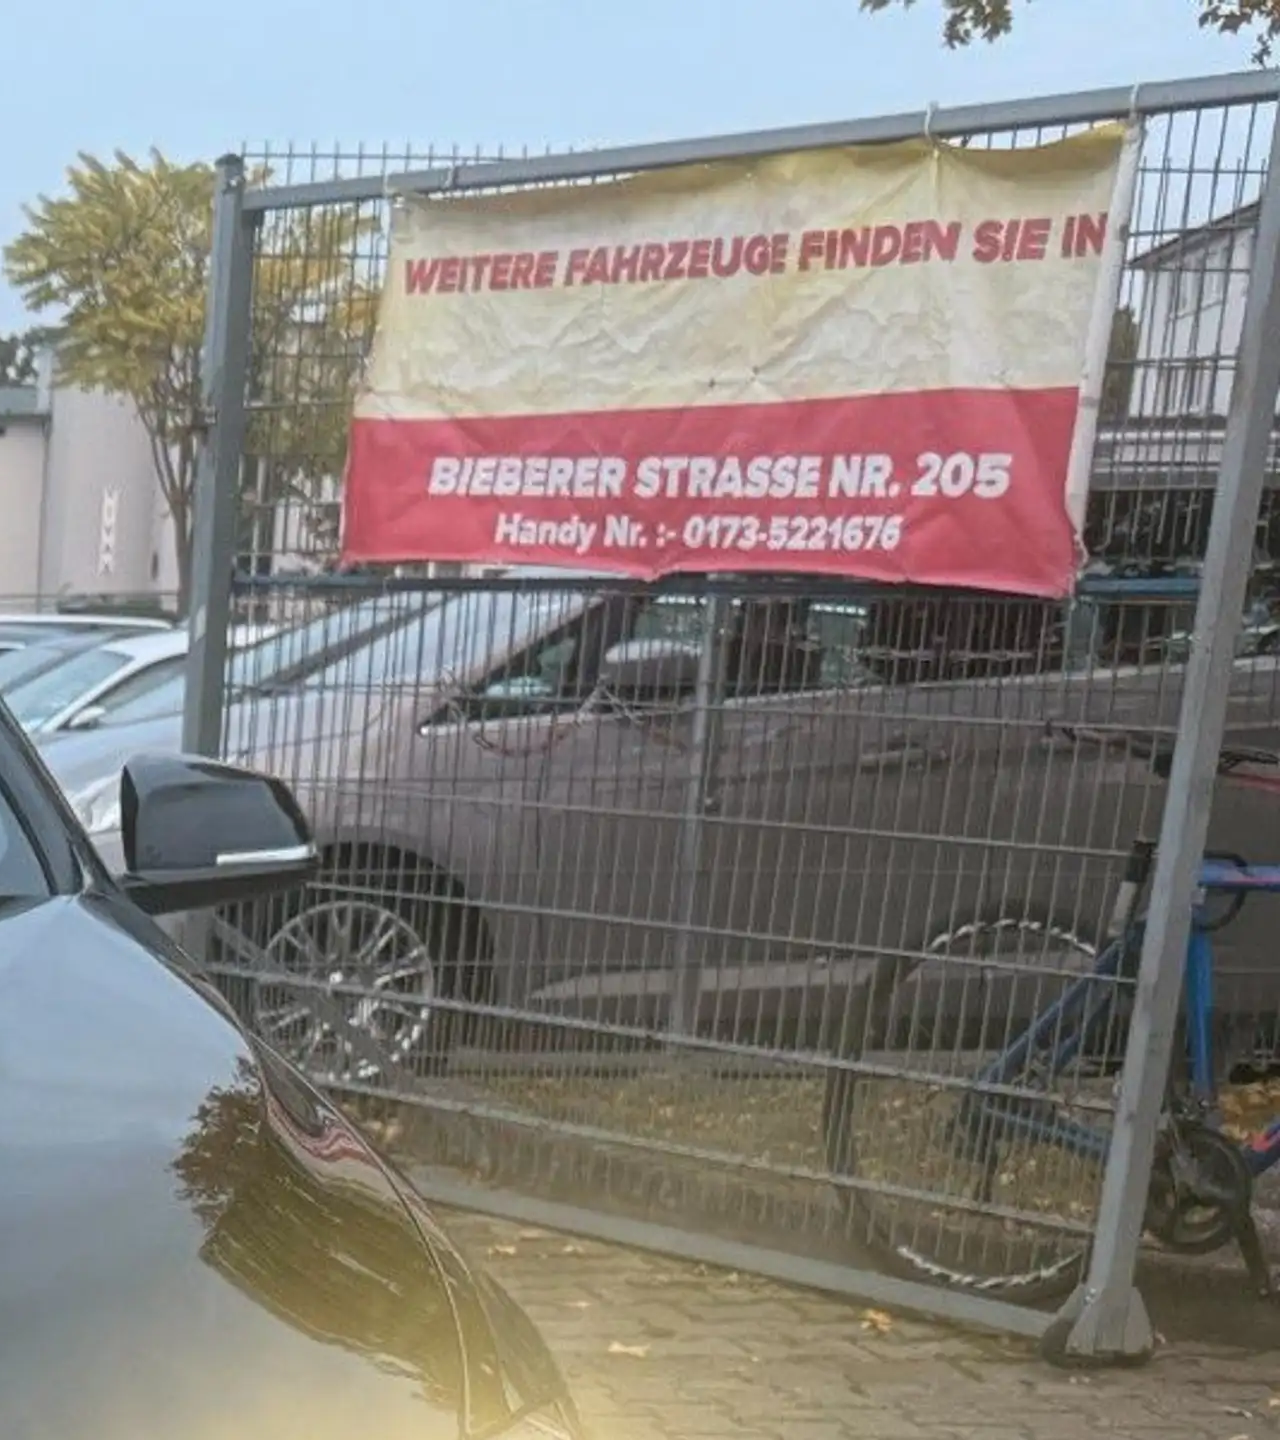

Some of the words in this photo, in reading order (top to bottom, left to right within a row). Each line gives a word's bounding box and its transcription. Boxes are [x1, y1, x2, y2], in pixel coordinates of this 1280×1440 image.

[404, 250, 559, 296] WEITERE
[564, 231, 790, 287] FAHRZEUGE
[797, 218, 962, 272] FINDEN
[972, 216, 1052, 264] SIE
[1060, 211, 1108, 259] IN
[427, 456, 628, 497] BIEBERER
[634, 455, 824, 499] STRASSE
[828, 454, 901, 499] NR.
[910, 451, 1013, 499] 205
[494, 512, 597, 555] Handy
[603, 513, 648, 547] Nr.
[682, 514, 904, 551] 0173-5221676
